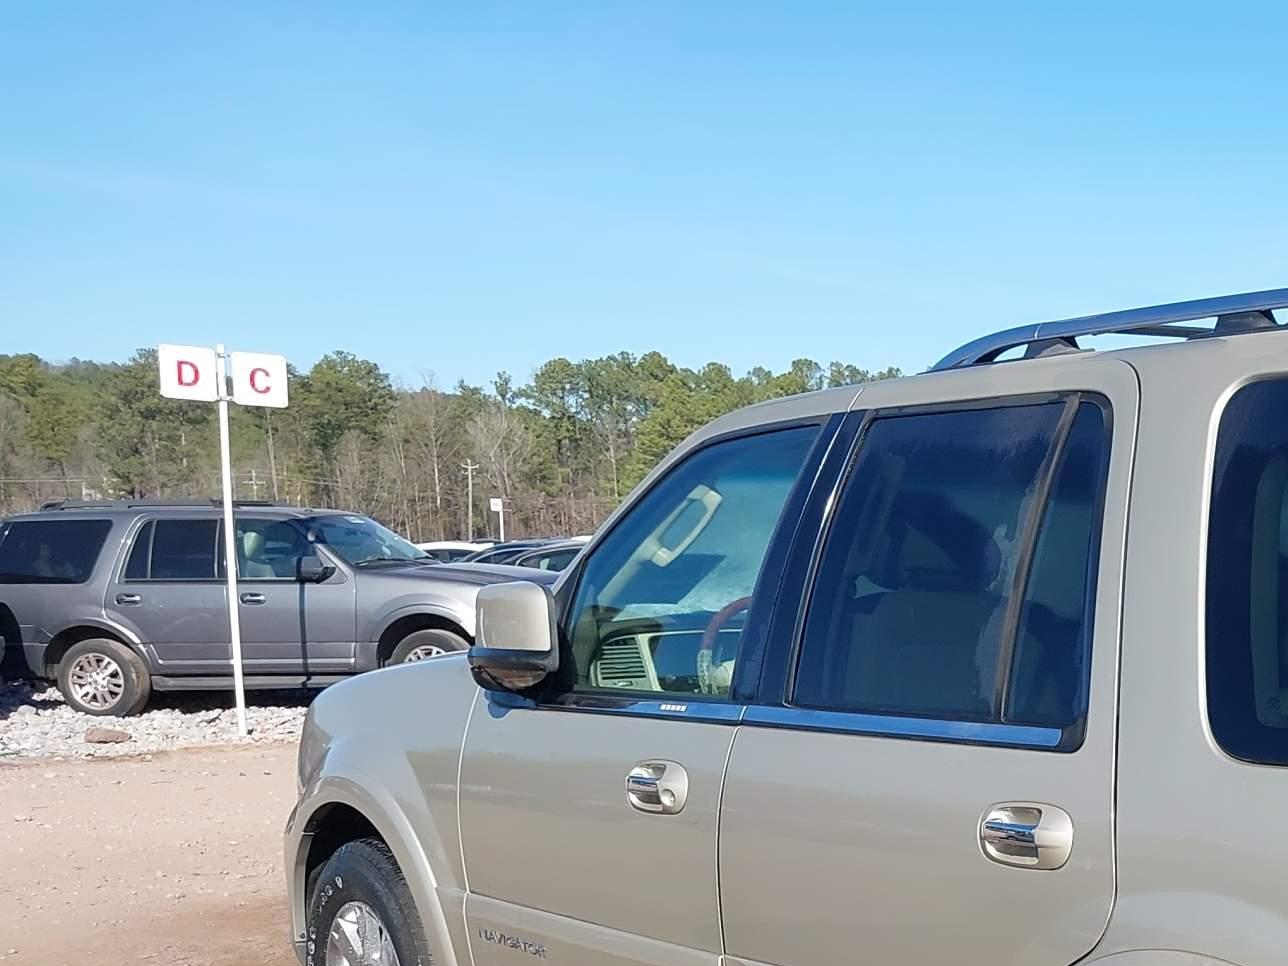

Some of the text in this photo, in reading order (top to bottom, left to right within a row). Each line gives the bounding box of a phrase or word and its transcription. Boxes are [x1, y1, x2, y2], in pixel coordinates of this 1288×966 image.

[176, 360, 200, 387] D
[249, 367, 271, 394] C
[478, 927, 547, 959] NAVIGATOR
